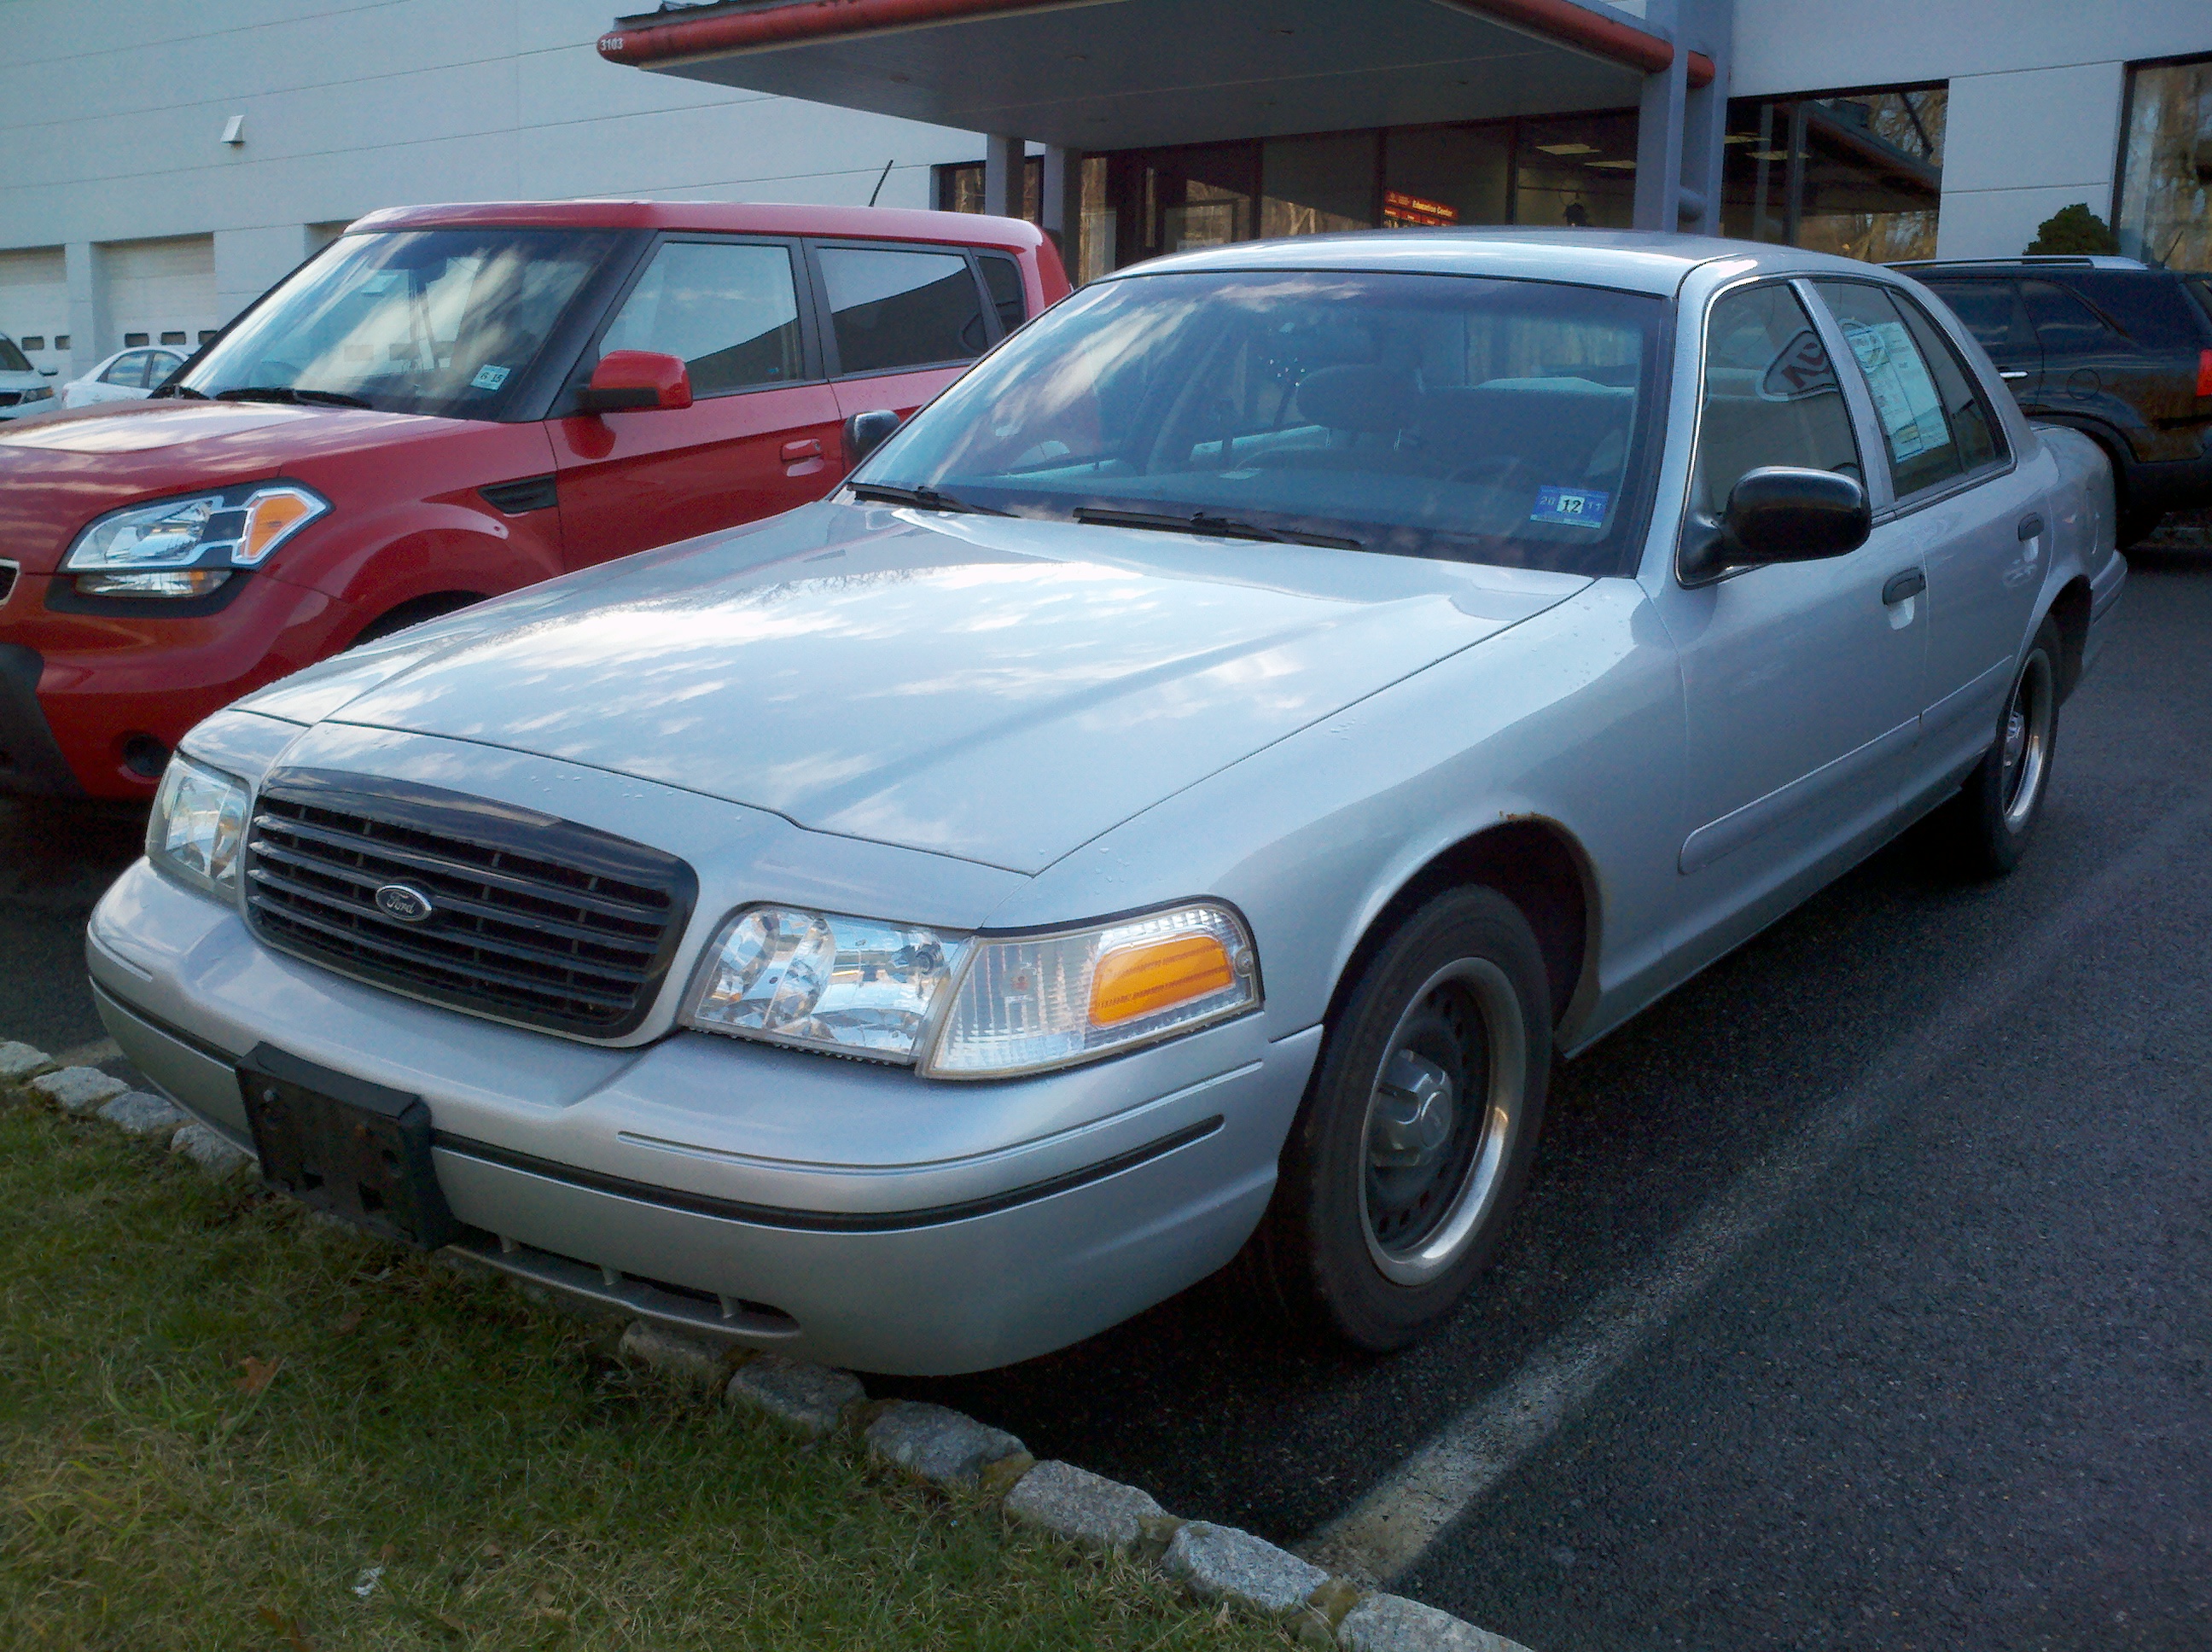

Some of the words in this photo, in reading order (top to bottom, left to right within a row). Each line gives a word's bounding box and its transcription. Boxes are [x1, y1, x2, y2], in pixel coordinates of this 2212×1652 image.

[600, 38, 623, 51] 3103
[1563, 499, 1581, 513] 12
[387, 892, 416, 914] Ford
